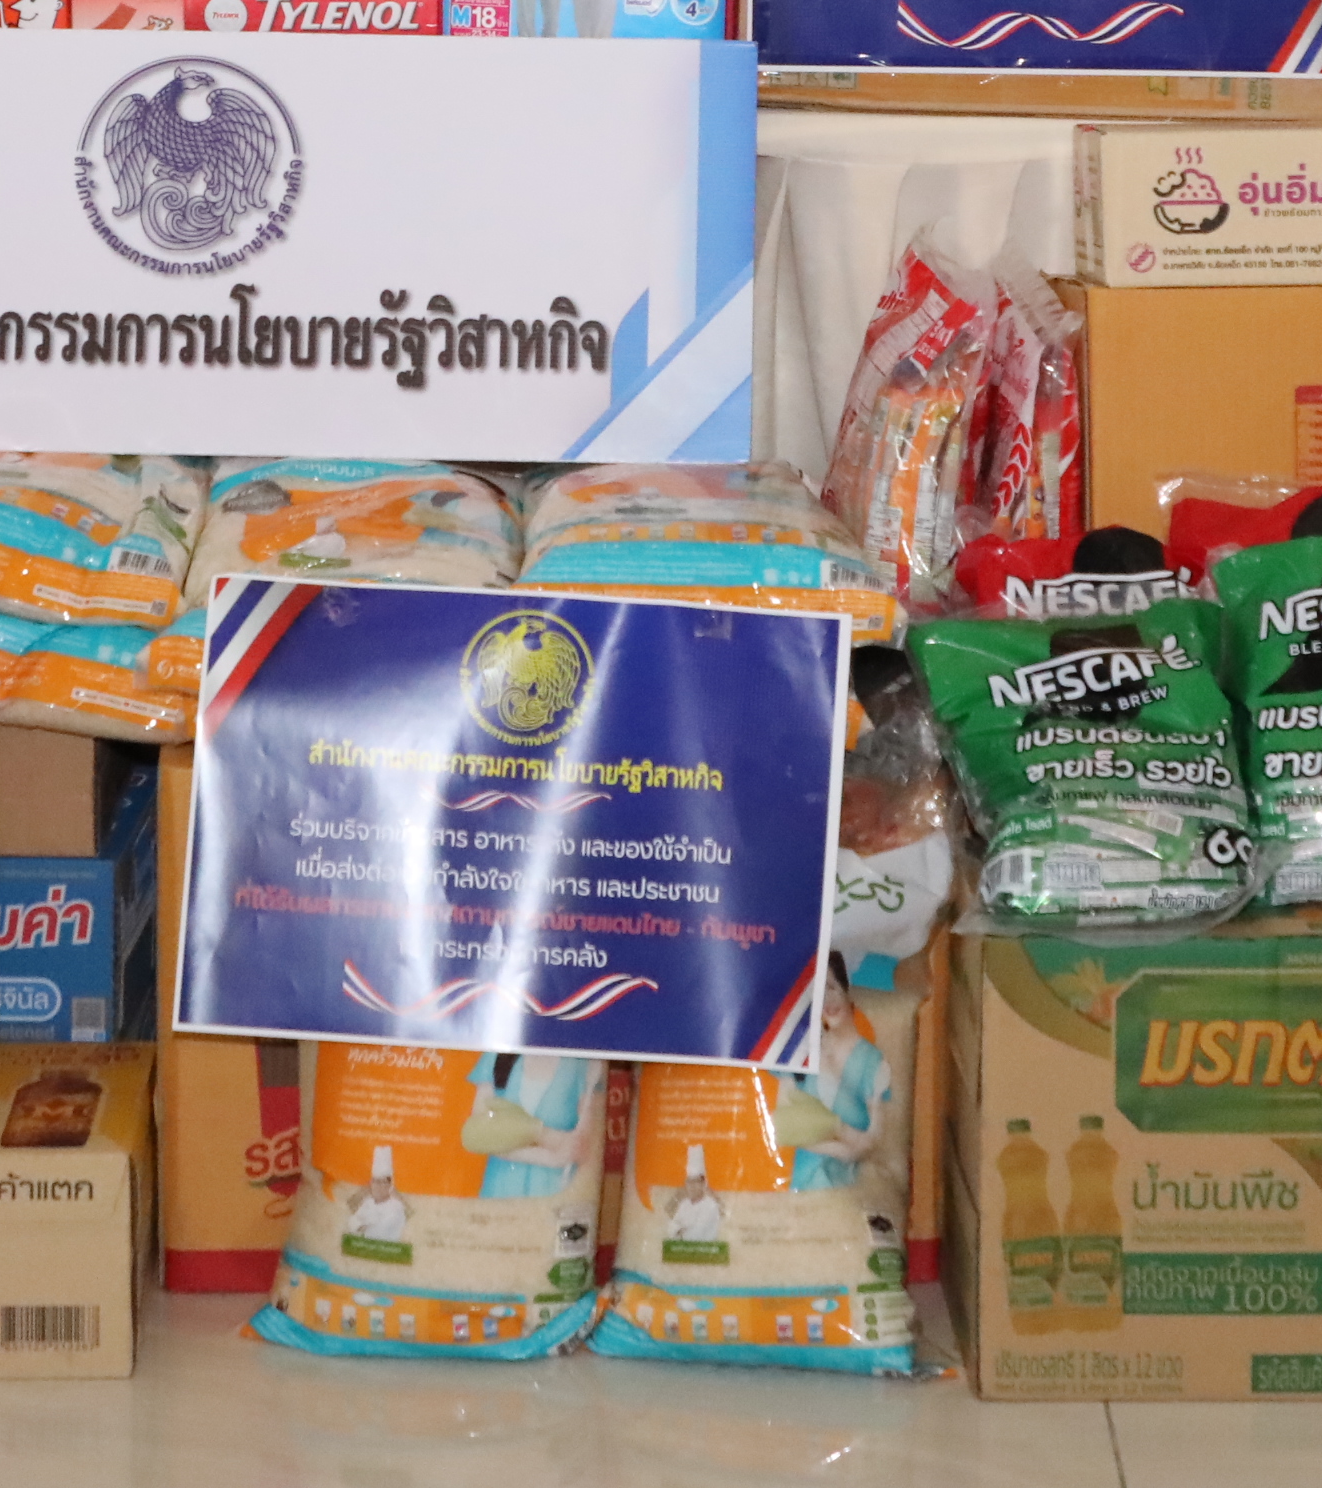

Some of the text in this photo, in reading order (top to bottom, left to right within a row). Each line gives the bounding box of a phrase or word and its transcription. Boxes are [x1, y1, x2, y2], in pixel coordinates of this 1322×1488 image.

[451, 5, 497, 29] M 18
[988, 636, 1197, 709] NESCAFÉ
[1117, 685, 1169, 712] BREW
[1026, 749, 1233, 788] ขายเร็ว รวยไว
[580, 832, 732, 865] และของใช้จำเป็น
[597, 874, 720, 904] และประชาชน
[1132, 1162, 1301, 1213] น้ำมันพืช
[1223, 1285, 1319, 1313] 100%
